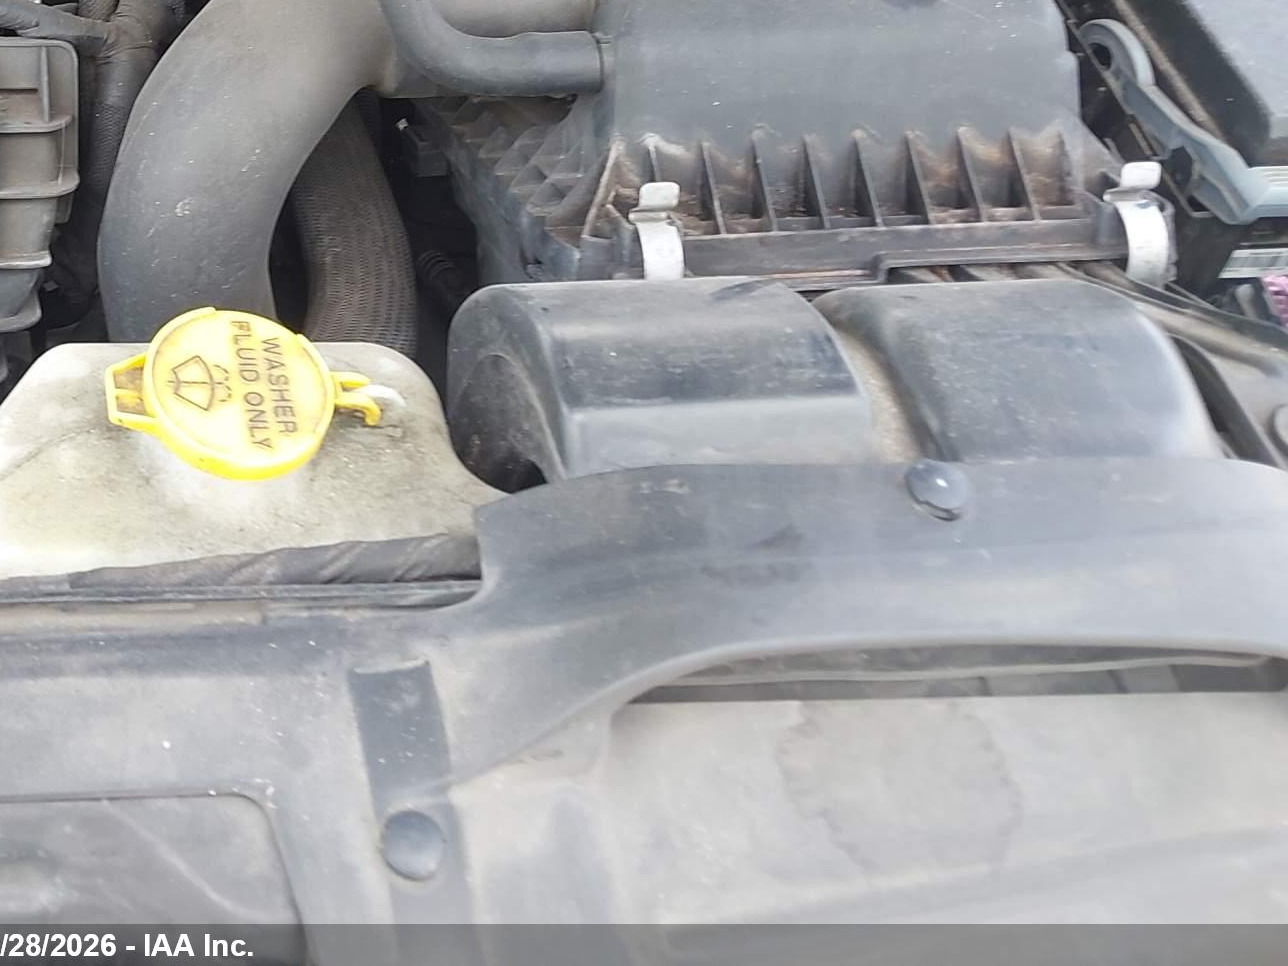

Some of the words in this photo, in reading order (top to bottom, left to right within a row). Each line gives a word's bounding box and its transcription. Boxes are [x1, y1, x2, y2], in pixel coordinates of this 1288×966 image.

[230, 320, 260, 383] FLUID
[261, 337, 298, 434] WASHER
[243, 391, 274, 450] ONLY
